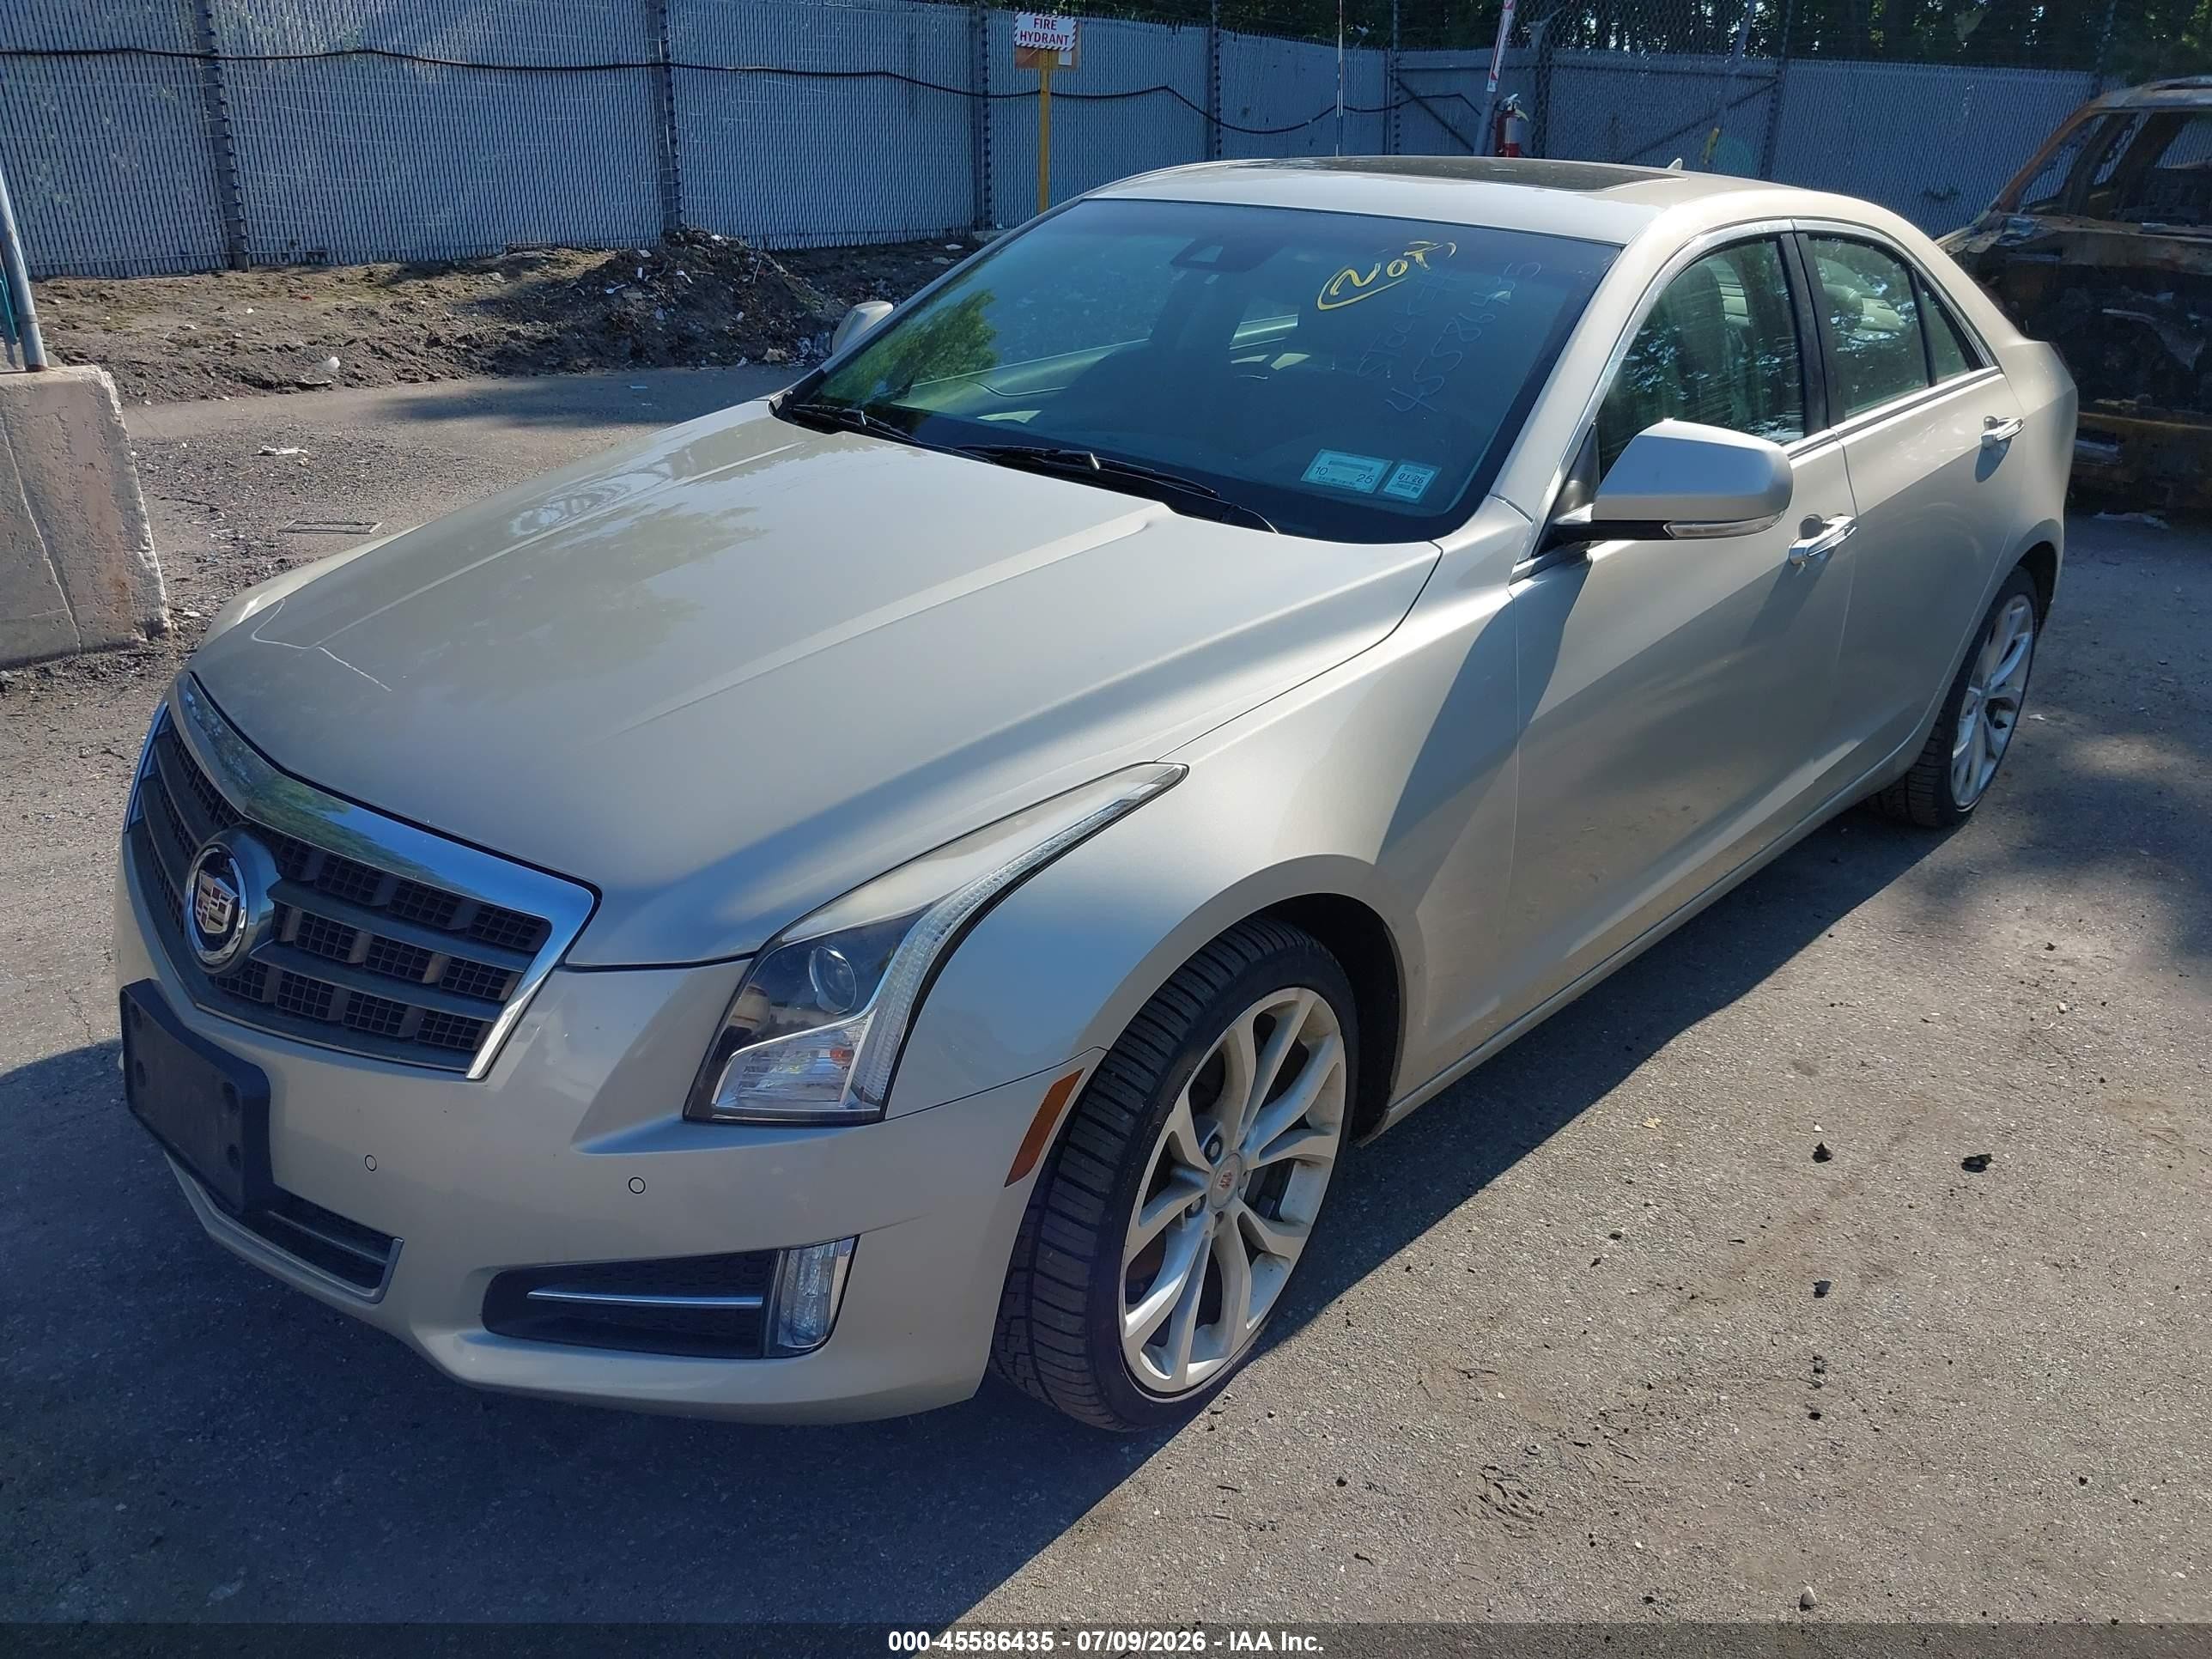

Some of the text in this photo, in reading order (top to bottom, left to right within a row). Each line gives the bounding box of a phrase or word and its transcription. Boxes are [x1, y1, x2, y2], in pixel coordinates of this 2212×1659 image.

[1033, 18, 1058, 30] FIRE
[1019, 30, 1070, 46] HYDRANT
[1315, 466, 1328, 476] 10
[1356, 473, 1375, 484] 25
